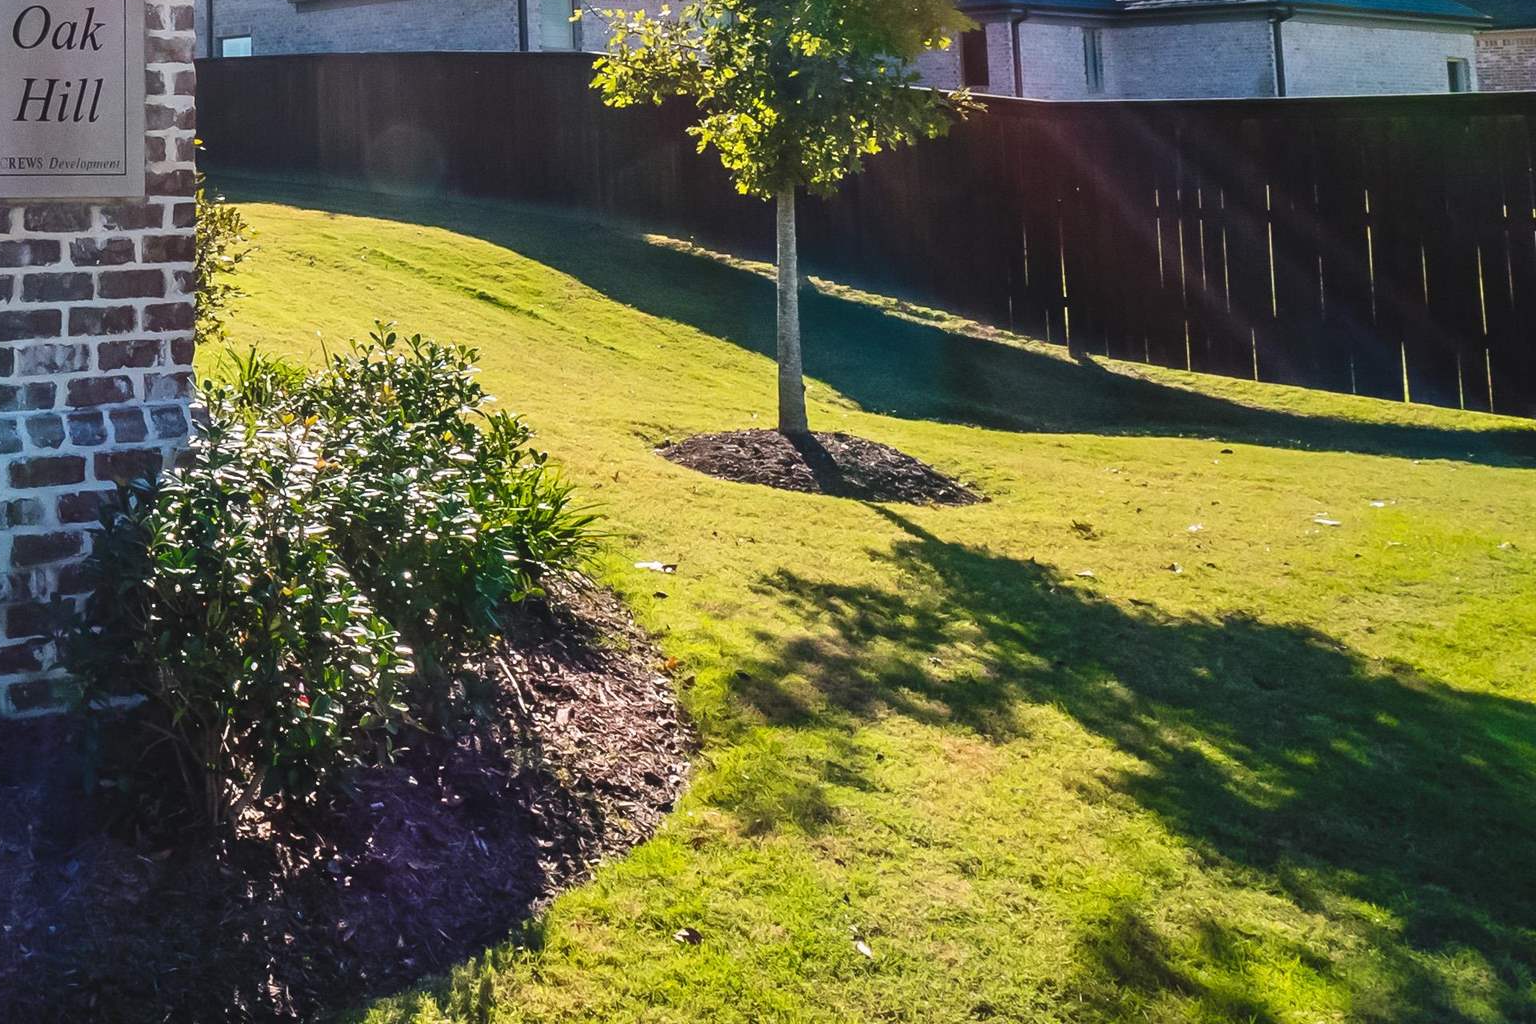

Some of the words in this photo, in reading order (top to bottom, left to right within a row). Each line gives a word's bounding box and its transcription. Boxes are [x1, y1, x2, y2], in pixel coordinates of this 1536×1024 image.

[12, 5, 106, 51] Oak
[12, 78, 104, 123] Hill
[0, 157, 44, 170] CREWS
[48, 157, 121, 171] Development
